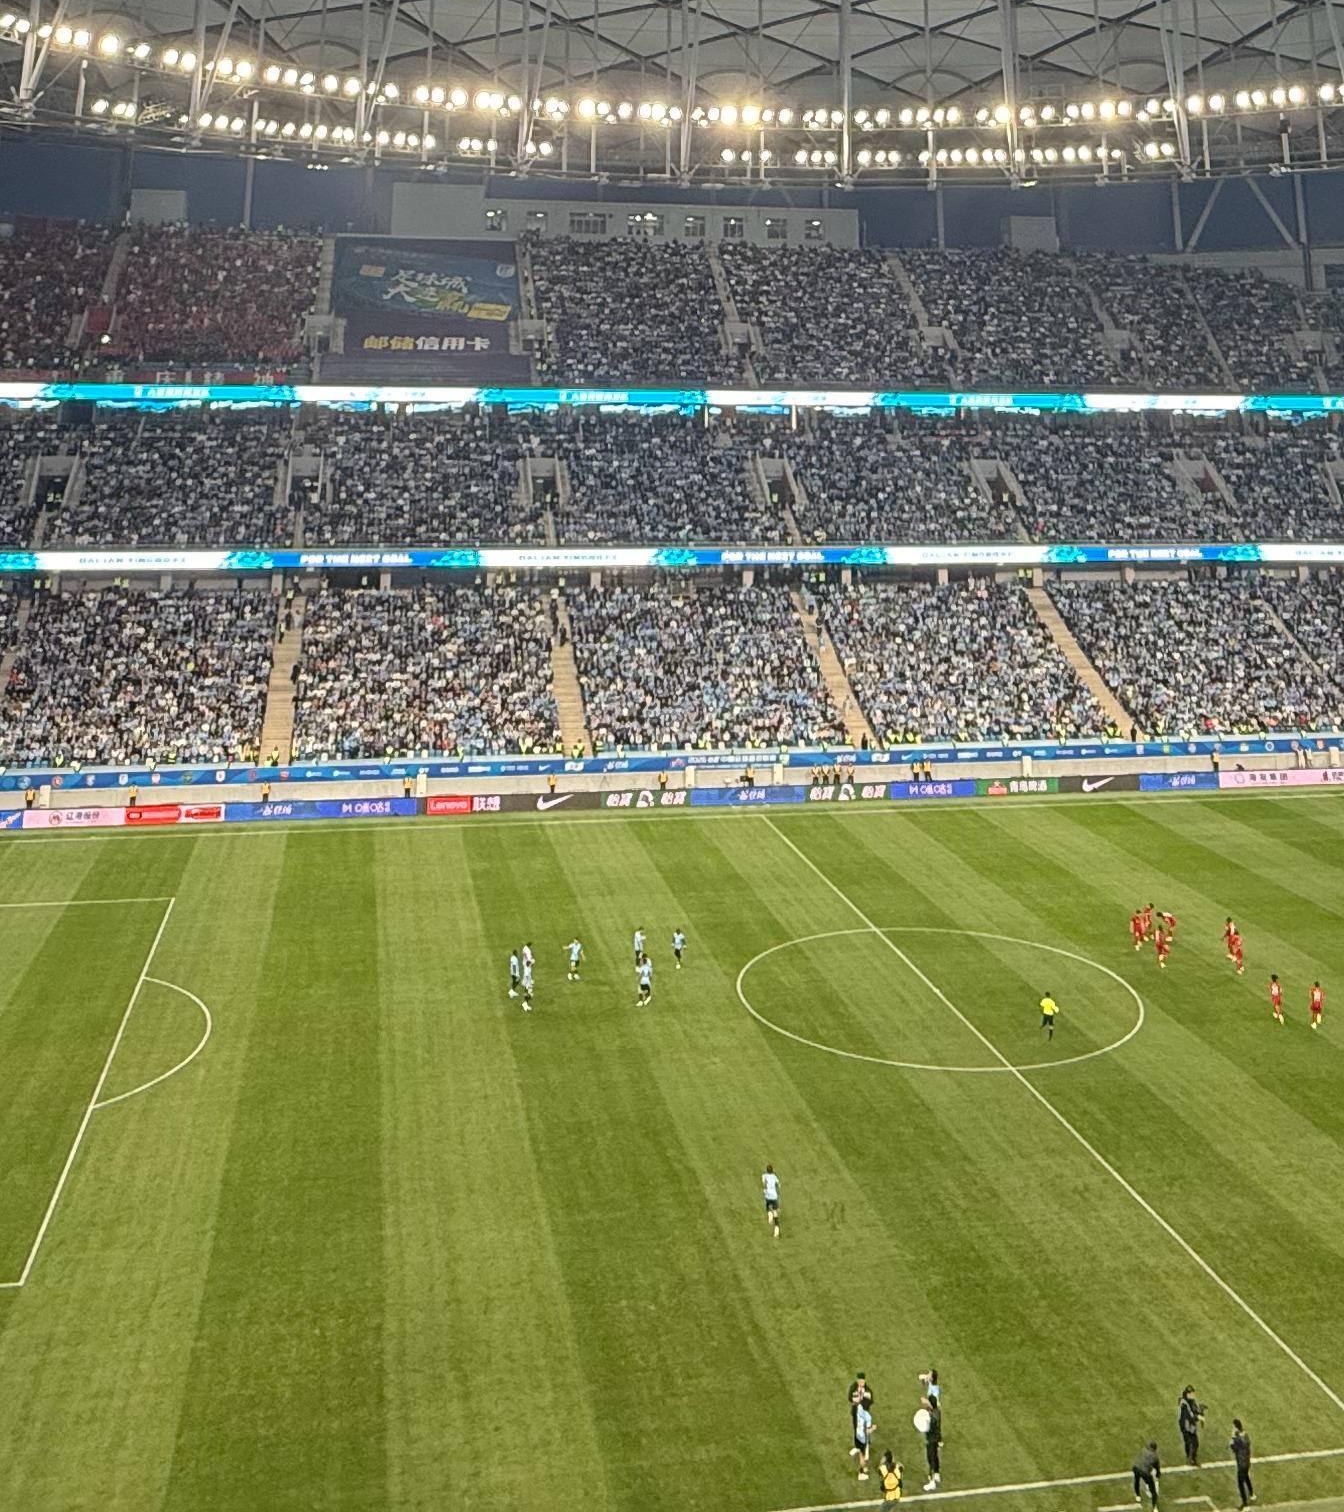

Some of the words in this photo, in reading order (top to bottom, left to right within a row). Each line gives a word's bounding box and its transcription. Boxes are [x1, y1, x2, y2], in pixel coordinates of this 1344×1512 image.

[362, 335, 491, 351] 邮储信用卡
